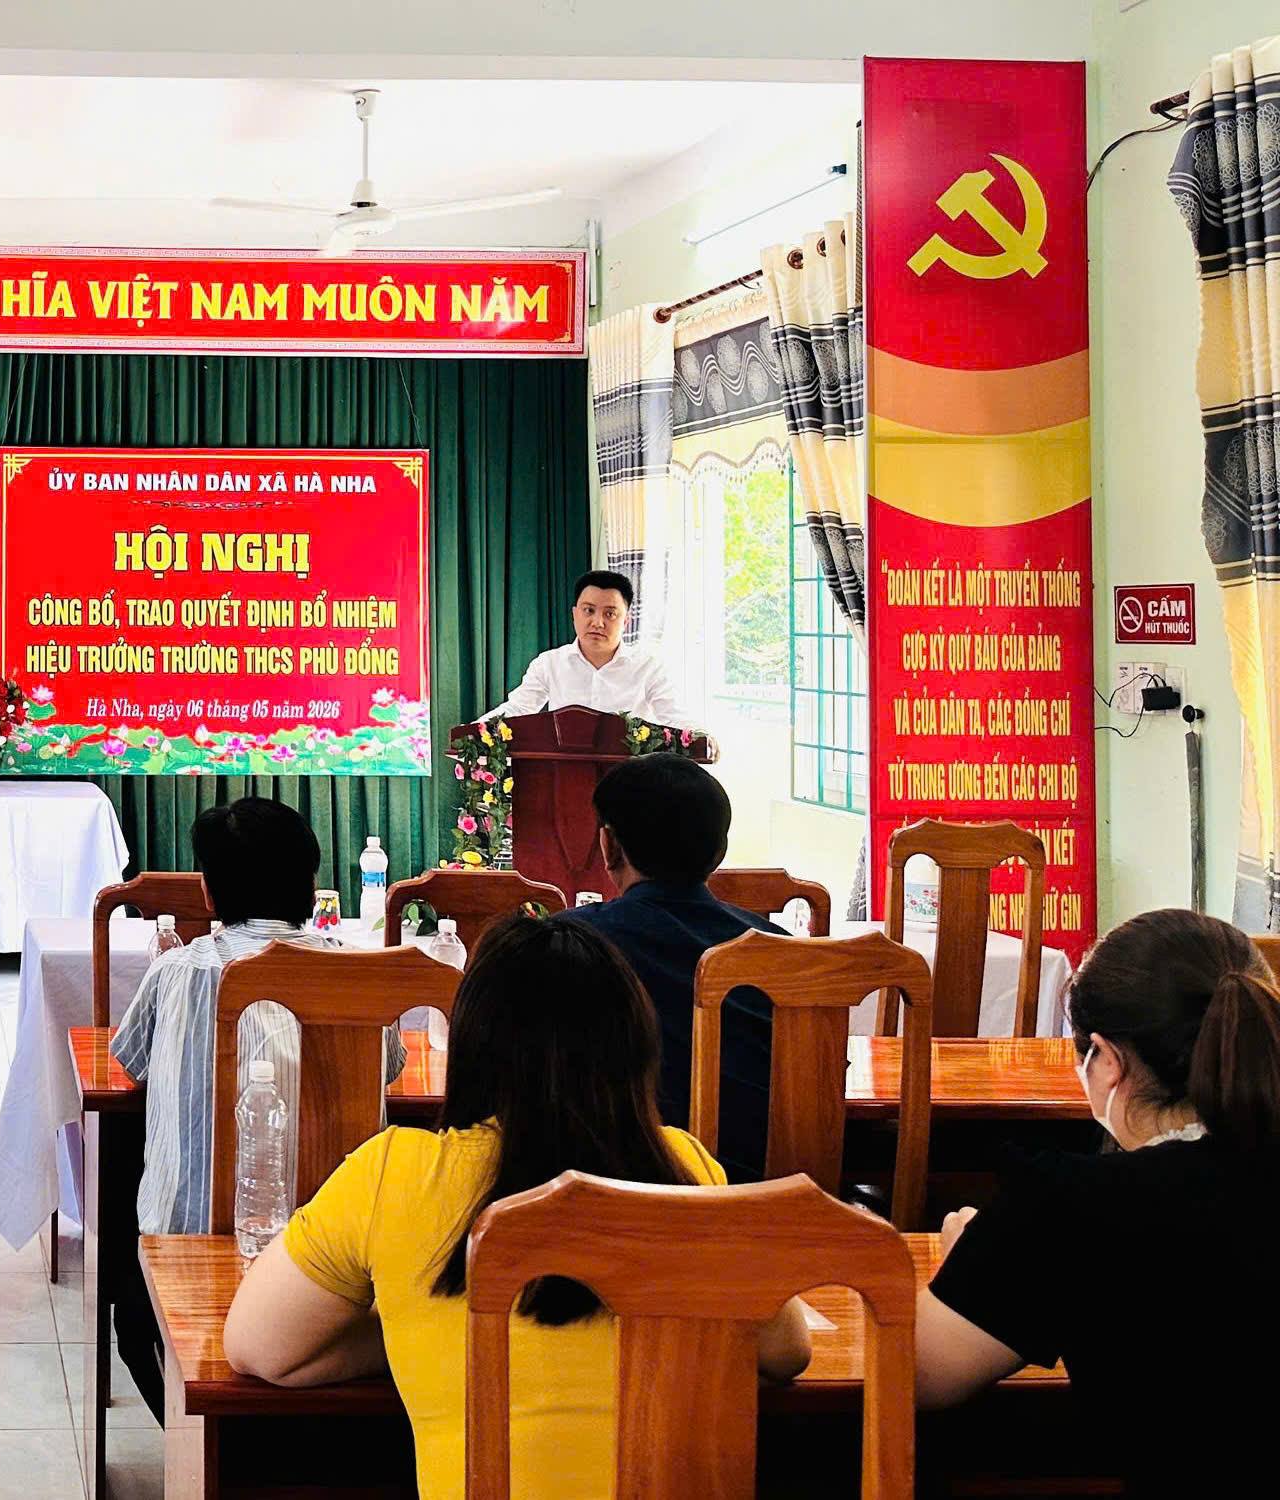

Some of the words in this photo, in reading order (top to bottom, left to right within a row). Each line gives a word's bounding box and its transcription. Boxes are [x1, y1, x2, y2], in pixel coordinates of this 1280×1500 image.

[88, 273, 178, 328] VIỆT
[191, 283, 288, 321] NAM
[302, 275, 436, 322] MUÔN
[450, 277, 549, 323] NĂM
[49, 467, 77, 490] ỦY
[84, 473, 129, 491] BAN
[136, 471, 198, 491] NHÂN
[206, 471, 251, 492] DÂN
[258, 472, 288, 492] XÃ
[295, 472, 324, 492] HÀ
[331, 475, 377, 492] NHA
[114, 524, 189, 579] HỘI
[201, 533, 310, 579] NGHỊ
[881, 559, 920, 606] “ĐOÀN
[923, 558, 945, 606] KẾT
[948, 562, 963, 606] LÀ
[966, 562, 991, 615] MỘT
[994, 559, 1039, 607] TRUYỀN
[1042, 558, 1081, 607] THỐNG
[1147, 595, 1186, 617] CẤM
[28, 593, 82, 626] CÔNG
[88, 589, 120, 629] BỐ,
[126, 598, 174, 627] TRAO
[181, 591, 241, 629] QUYẾT
[247, 600, 294, 633] ĐỊNH
[301, 589, 327, 628] BỔ
[333, 595, 397, 634] NHIỆM
[1144, 620, 1161, 634] HÚT
[1162, 618, 1190, 634] THUỐC
[26, 640, 71, 679] HIỆU
[77, 636, 154, 674] TRƯỞNG
[160, 639, 238, 674] TRƯỜNG
[244, 647, 294, 675] THCS
[300, 641, 339, 675] PHÙ
[344, 636, 399, 675] ĐỔNG
[903, 630, 927, 679] CỰC
[929, 625, 946, 671] KỲ
[948, 627, 971, 675] QUÝ
[974, 626, 999, 672] BÁU
[1001, 622, 1026, 672] CỦA
[1028, 623, 1061, 672] ĐẢNG
[86, 698, 106, 717] Hà
[110, 698, 145, 719] Nha,
[149, 699, 183, 721] ngày
[186, 700, 203, 718] 06
[207, 699, 249, 722] tháng
[252, 700, 269, 718] 05
[272, 700, 304, 718] năm
[307, 699, 341, 718] 2026
[894, 690, 910, 735] VÀ
[912, 686, 937, 736] CỦA
[940, 691, 965, 736] DÂN
[967, 699, 985, 740] TA,
[988, 691, 1012, 736] CÁC
[1015, 687, 1048, 736] ĐỒNG
[1050, 691, 1071, 736] CHÍ
[888, 755, 905, 800] TỪ
[906, 763, 946, 801] TRUNG
[948, 759, 981, 801] ƯƠNG
[984, 751, 1009, 801] ĐẾN
[1011, 756, 1035, 801] CÁC
[1038, 763, 1058, 801] CHI
[1061, 756, 1078, 809] BỘ
[1053, 816, 1075, 865] KẾT
[1061, 884, 1081, 931] GÌN
